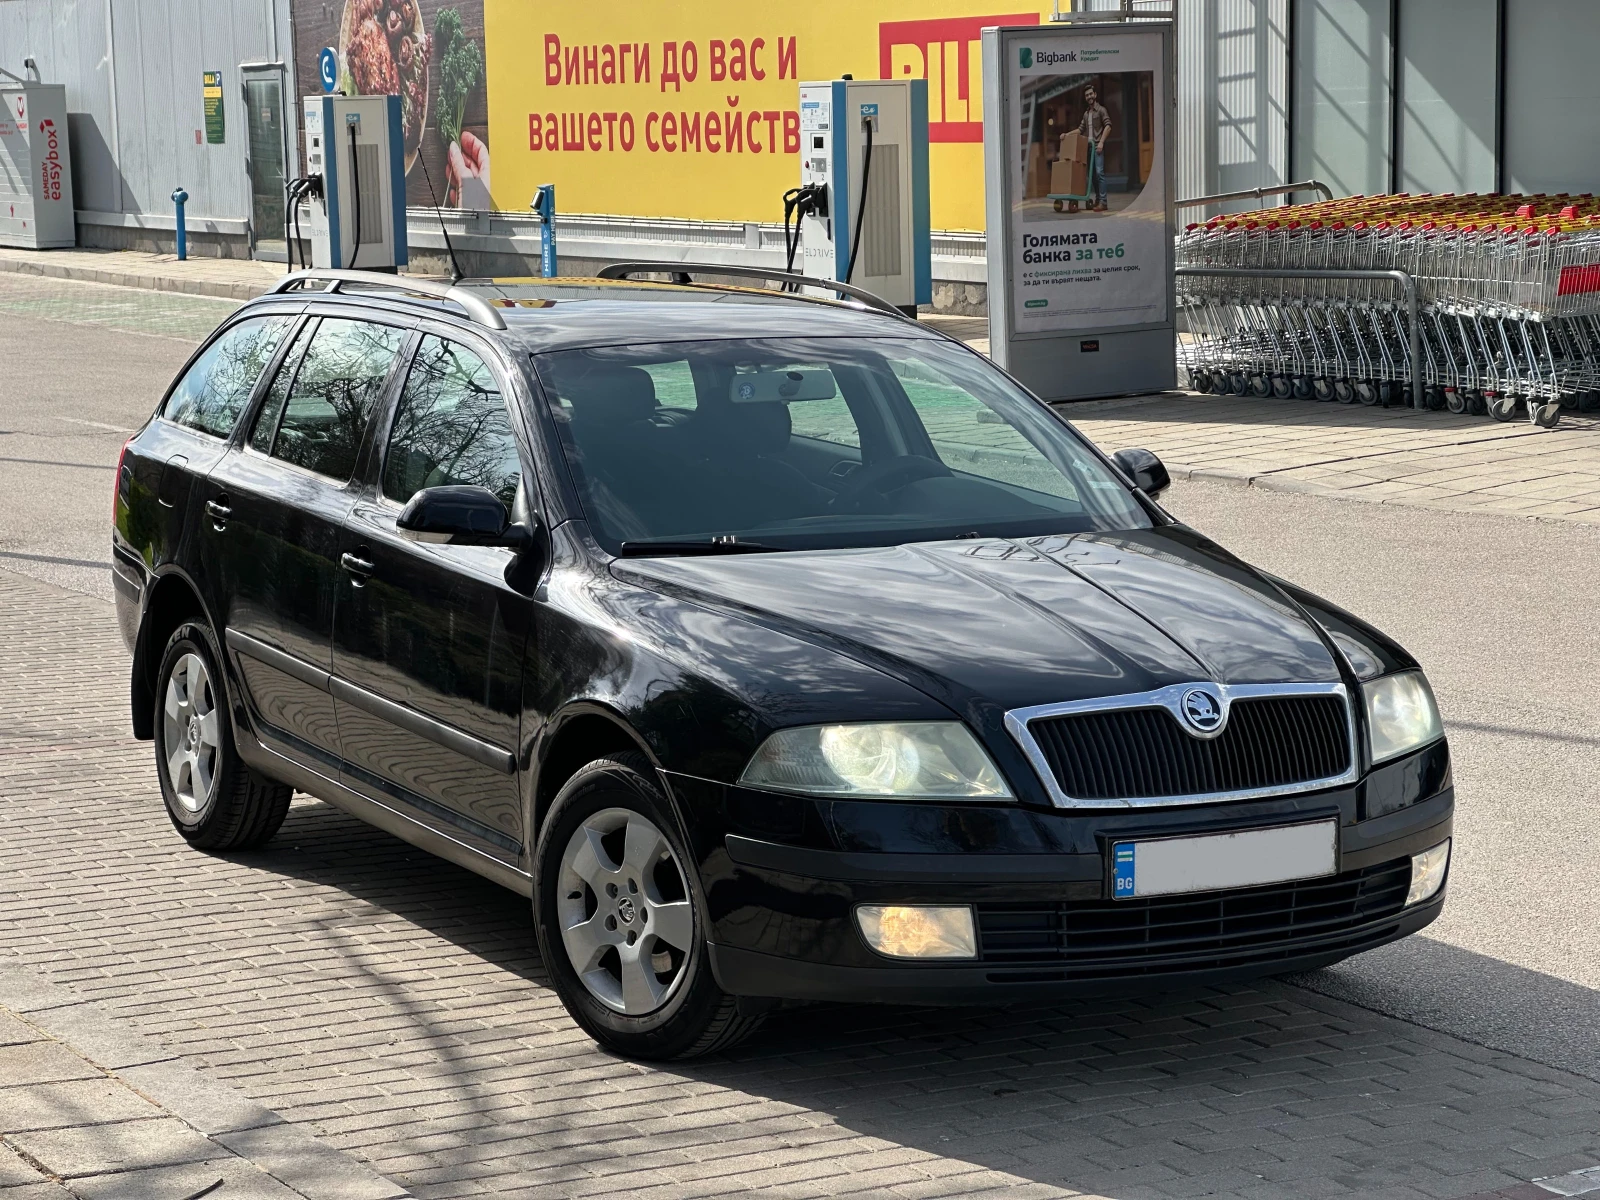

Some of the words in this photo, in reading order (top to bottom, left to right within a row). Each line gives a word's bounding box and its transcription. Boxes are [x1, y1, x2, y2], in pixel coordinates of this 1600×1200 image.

[544, 33, 650, 86] Винаги
[660, 40, 698, 92] до
[709, 37, 766, 82] вас
[777, 36, 797, 80] и
[1036, 51, 1077, 66] Bigbank
[528, 111, 635, 152] вашето
[645, 95, 801, 154] семейств
[45, 129, 62, 201] easybox
[41, 161, 50, 200] SAMEDAY
[1022, 232, 1098, 248] Голямата
[1022, 249, 1071, 264] банка
[1075, 248, 1093, 260] за
[1096, 243, 1125, 259] теб
[1034, 269, 1071, 278] фиксирана
[1101, 266, 1122, 274] целия
[1051, 277, 1074, 285] вървят
[1117, 877, 1133, 890] BG
